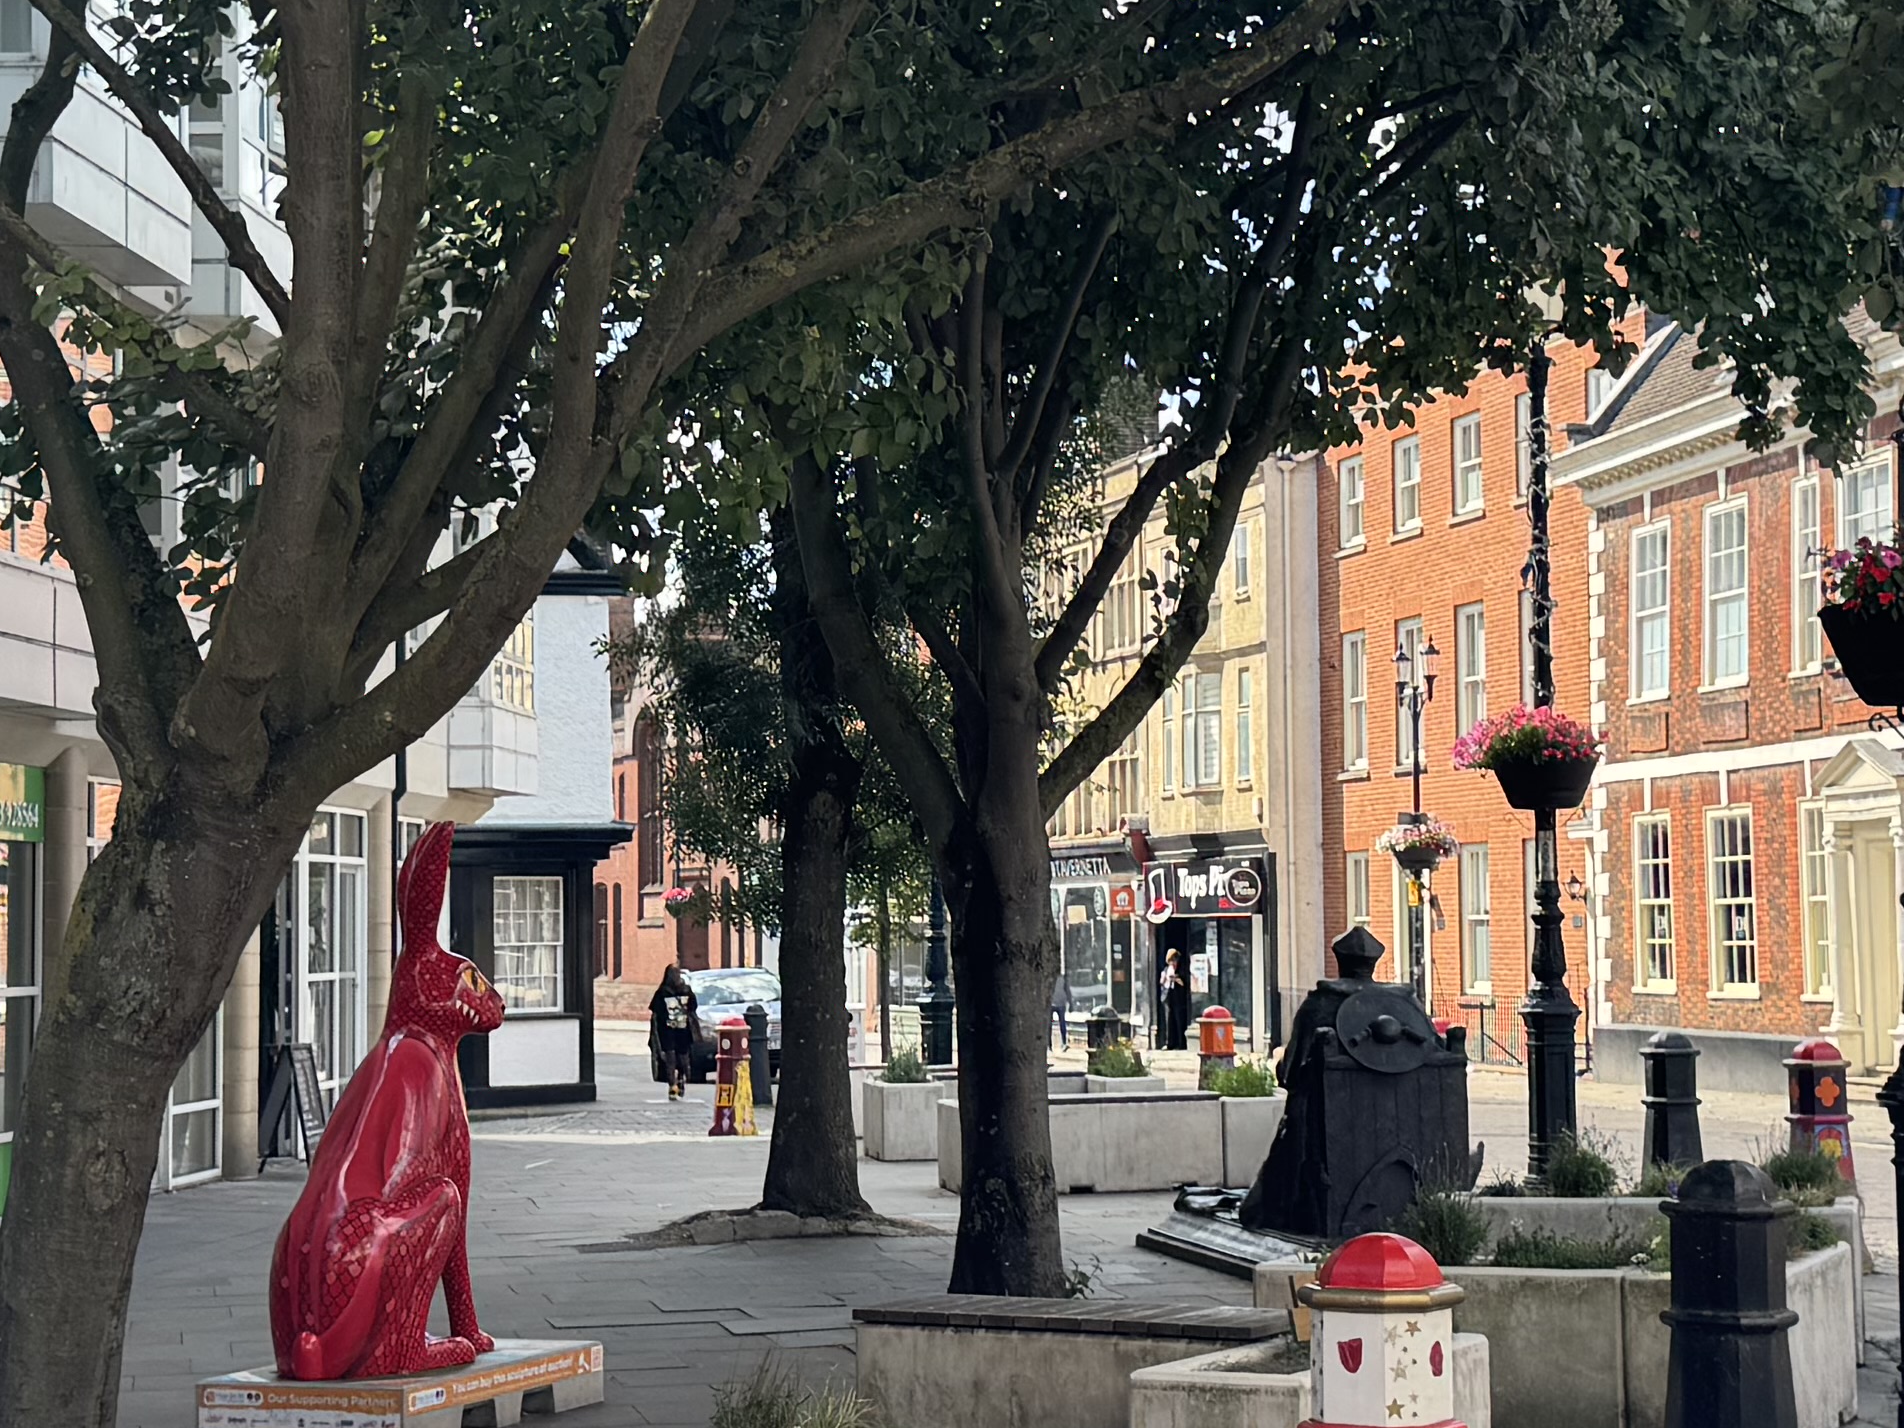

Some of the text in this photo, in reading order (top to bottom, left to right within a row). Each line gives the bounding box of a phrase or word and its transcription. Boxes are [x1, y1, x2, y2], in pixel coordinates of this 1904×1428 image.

[1177, 867, 1207, 909] Tops
[267, 1394, 287, 1404] Our
[289, 1394, 348, 1408] Supporting
